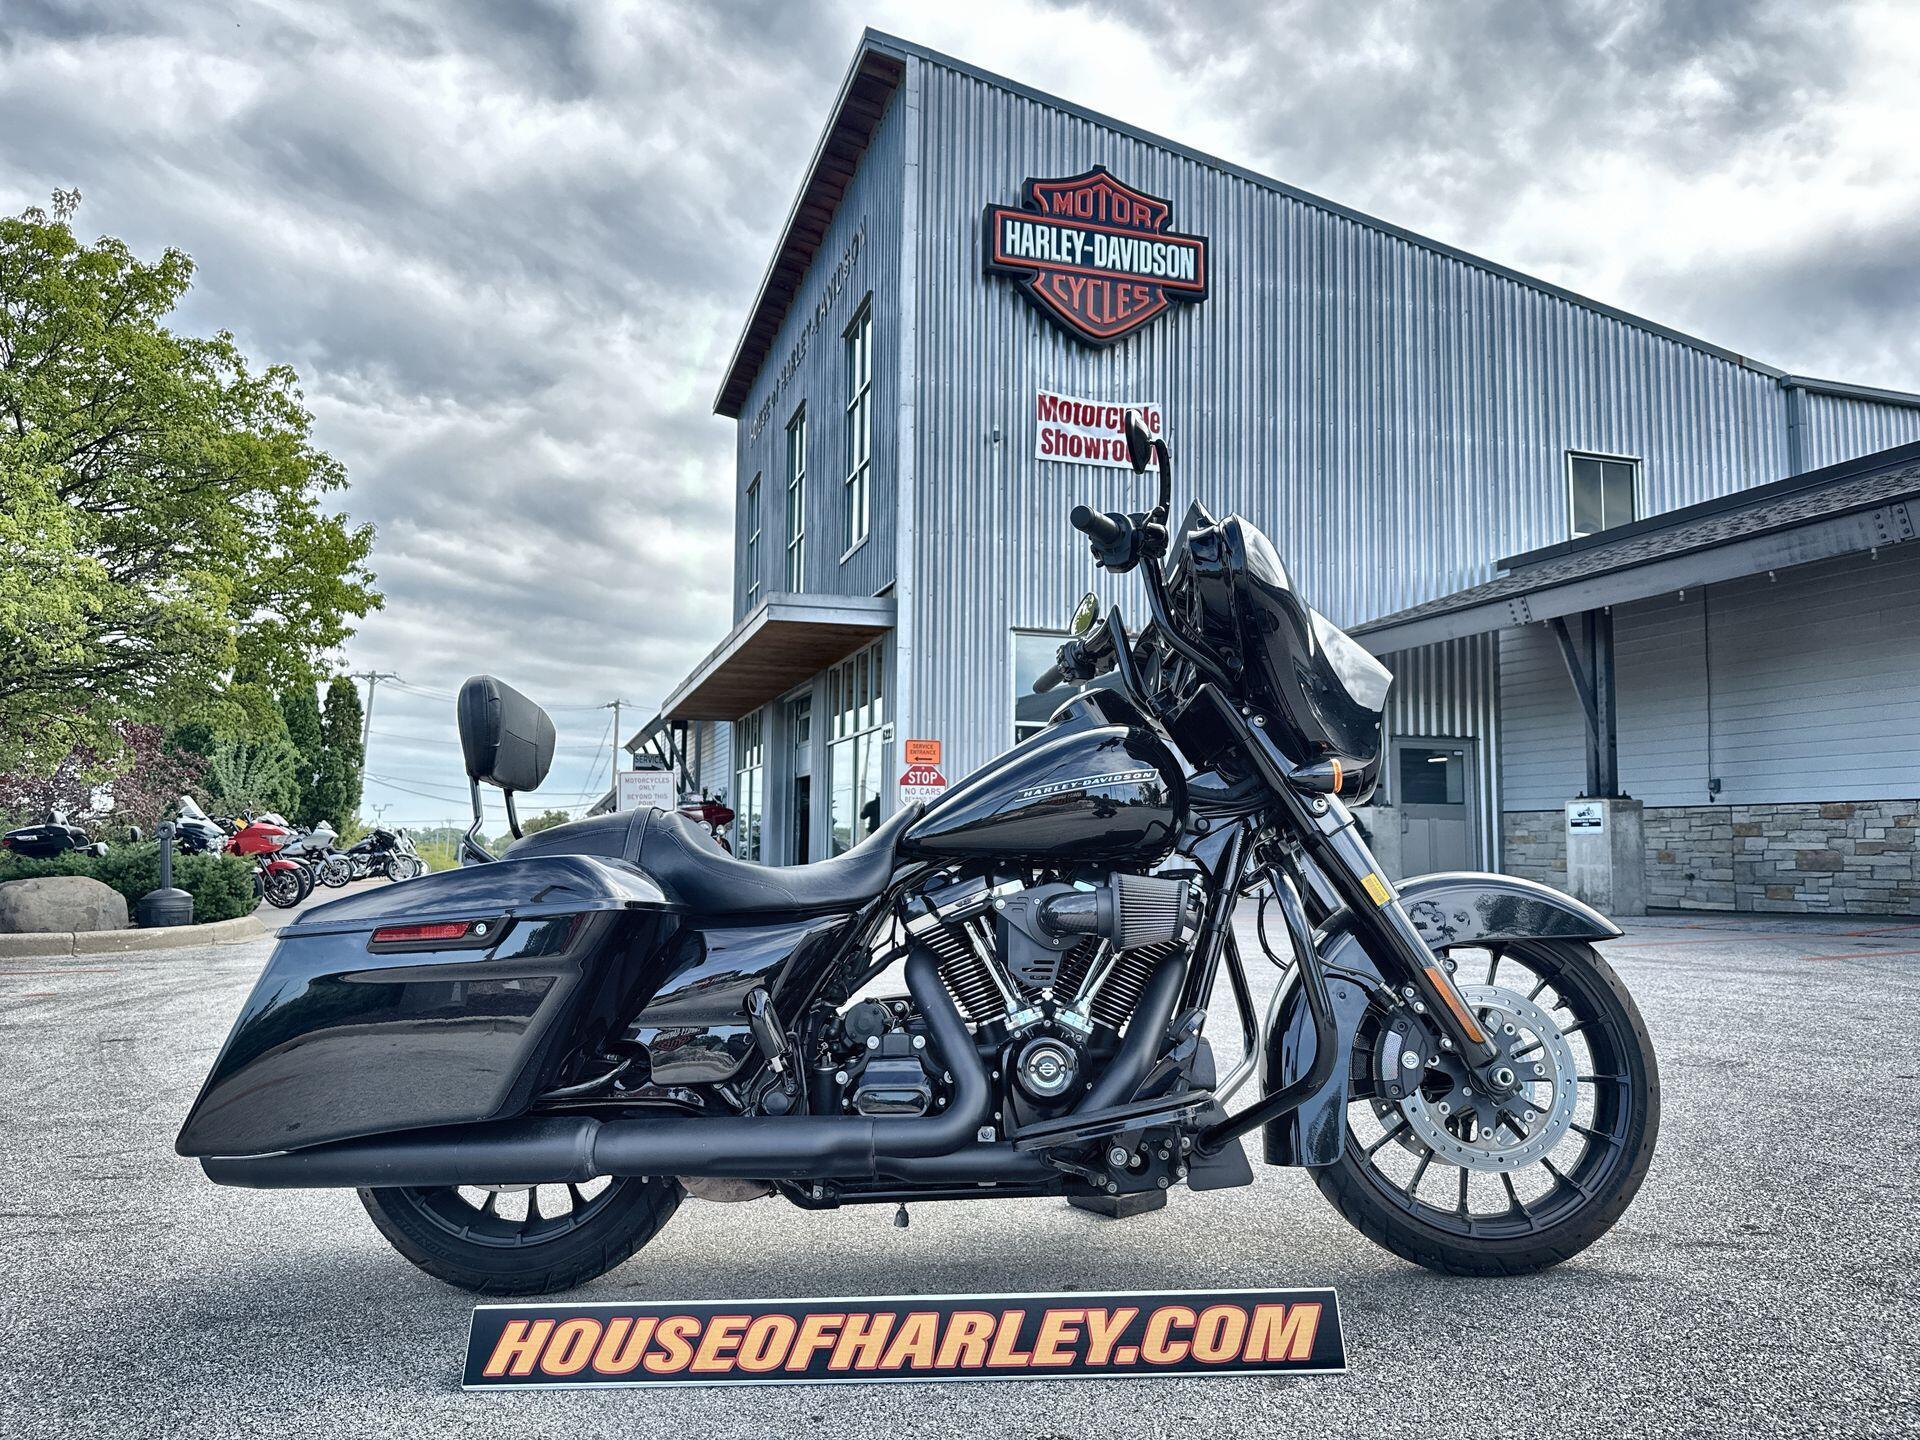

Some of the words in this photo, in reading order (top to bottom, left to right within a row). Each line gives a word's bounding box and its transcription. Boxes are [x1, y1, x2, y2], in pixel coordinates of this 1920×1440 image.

[1053, 184, 1151, 229] MOTOR
[1005, 220, 1195, 280] HARLEY-DAVIDSON
[1053, 274, 1149, 324] CYCLES
[1037, 394, 1160, 434] Motorcyle
[1041, 427, 1158, 465] Showro
[904, 787, 917, 796] NO
[919, 788, 941, 796] CARS
[908, 771, 938, 785] STOP
[1023, 772, 1152, 798] HARLEY-DAVIDSON
[482, 1302, 1322, 1376] HOUSEOFHARLEY.COM
